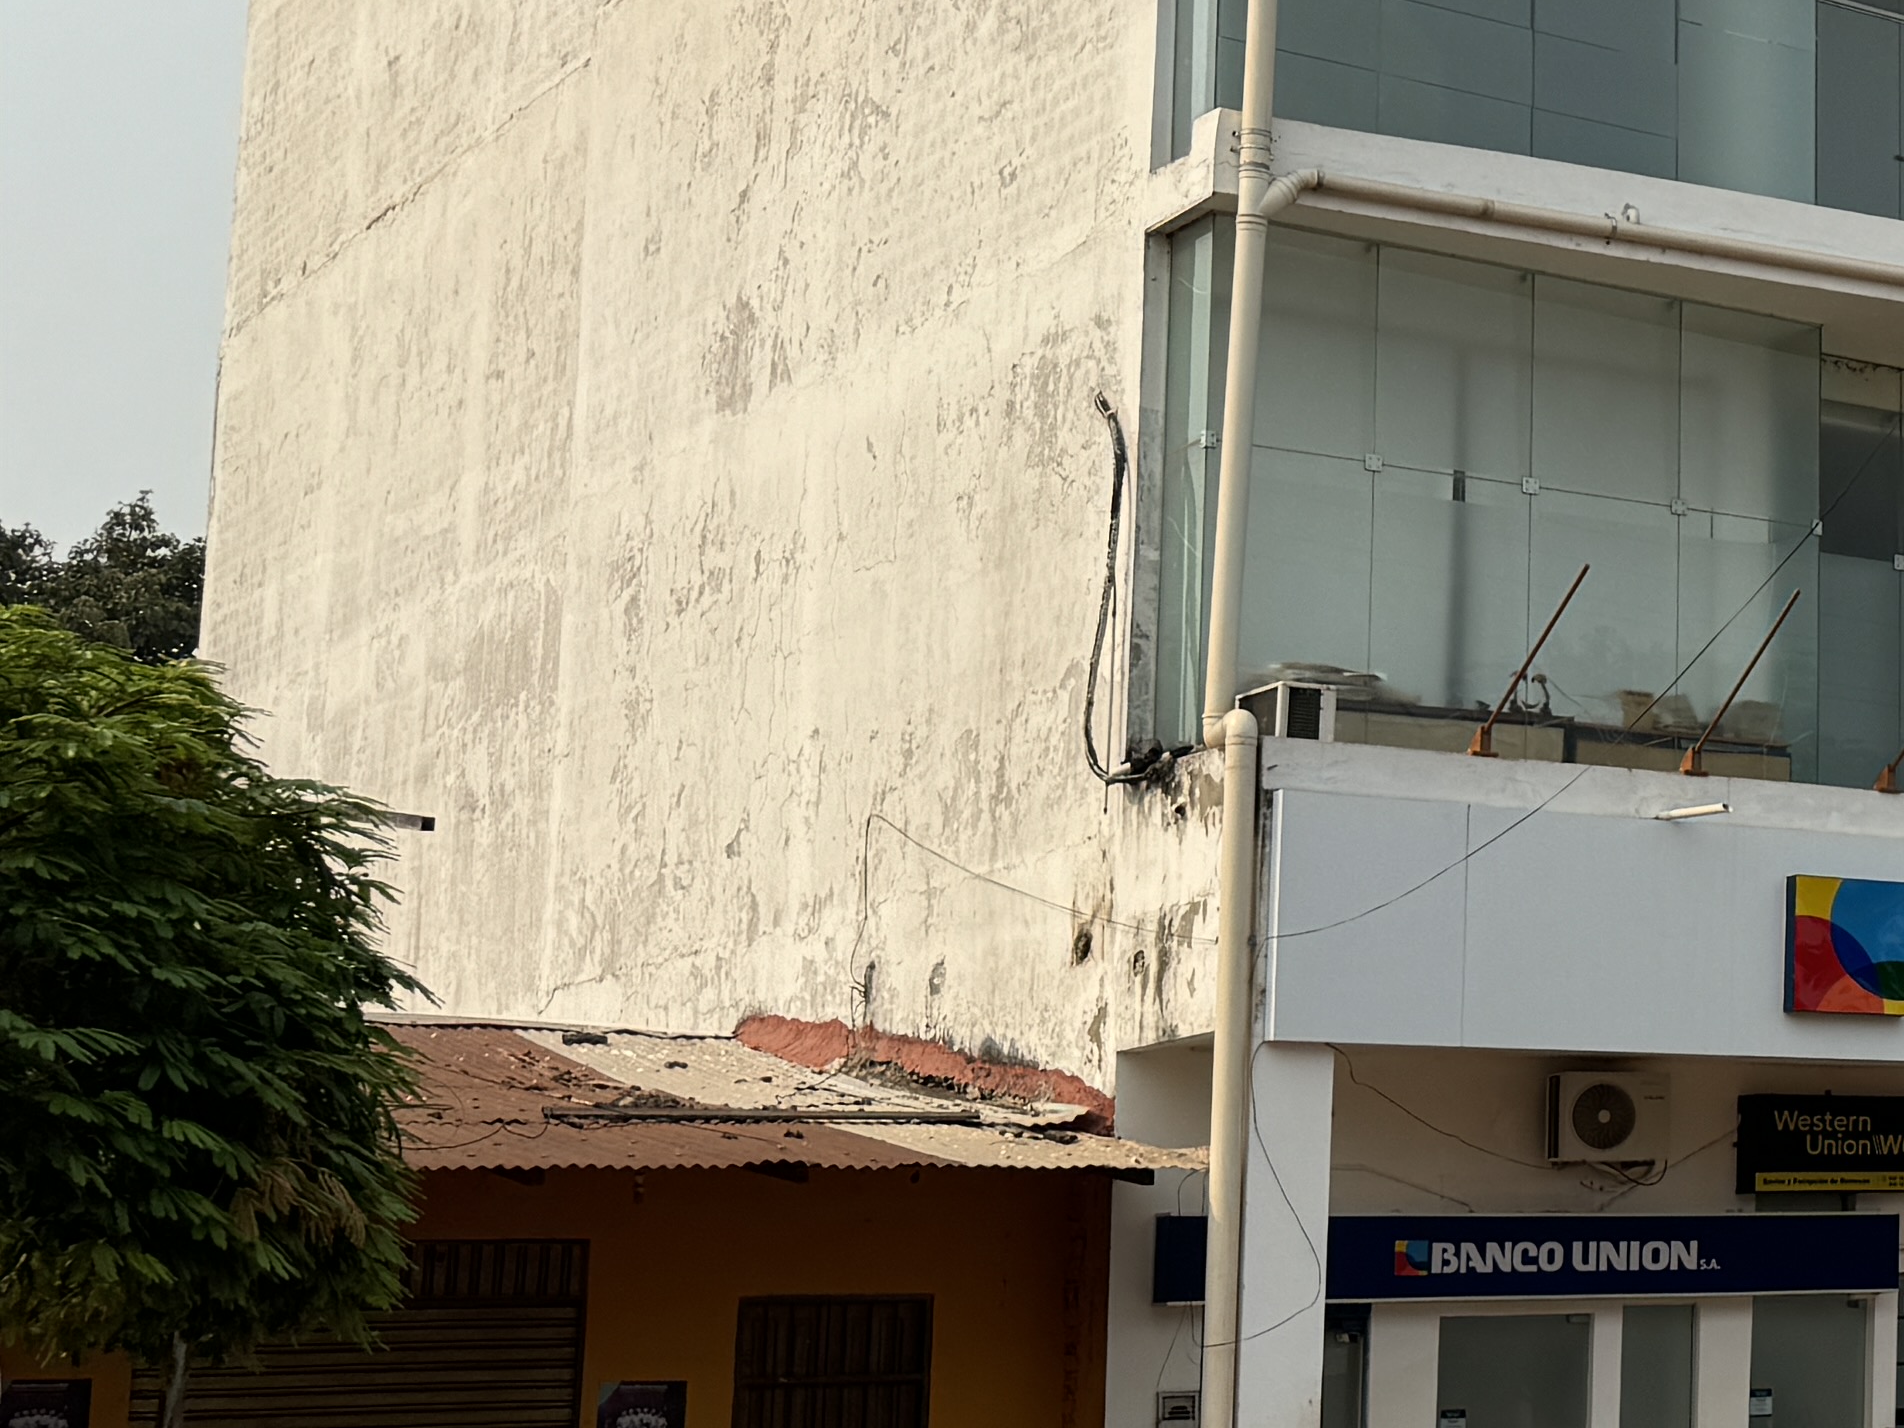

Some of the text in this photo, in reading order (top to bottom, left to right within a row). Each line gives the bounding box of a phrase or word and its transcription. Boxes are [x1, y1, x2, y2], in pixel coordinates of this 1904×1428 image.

[1773, 1109, 1872, 1132] Western
[1806, 1133, 1871, 1156] Union
[1431, 1240, 1721, 1274] BANCO UNION S.A.
